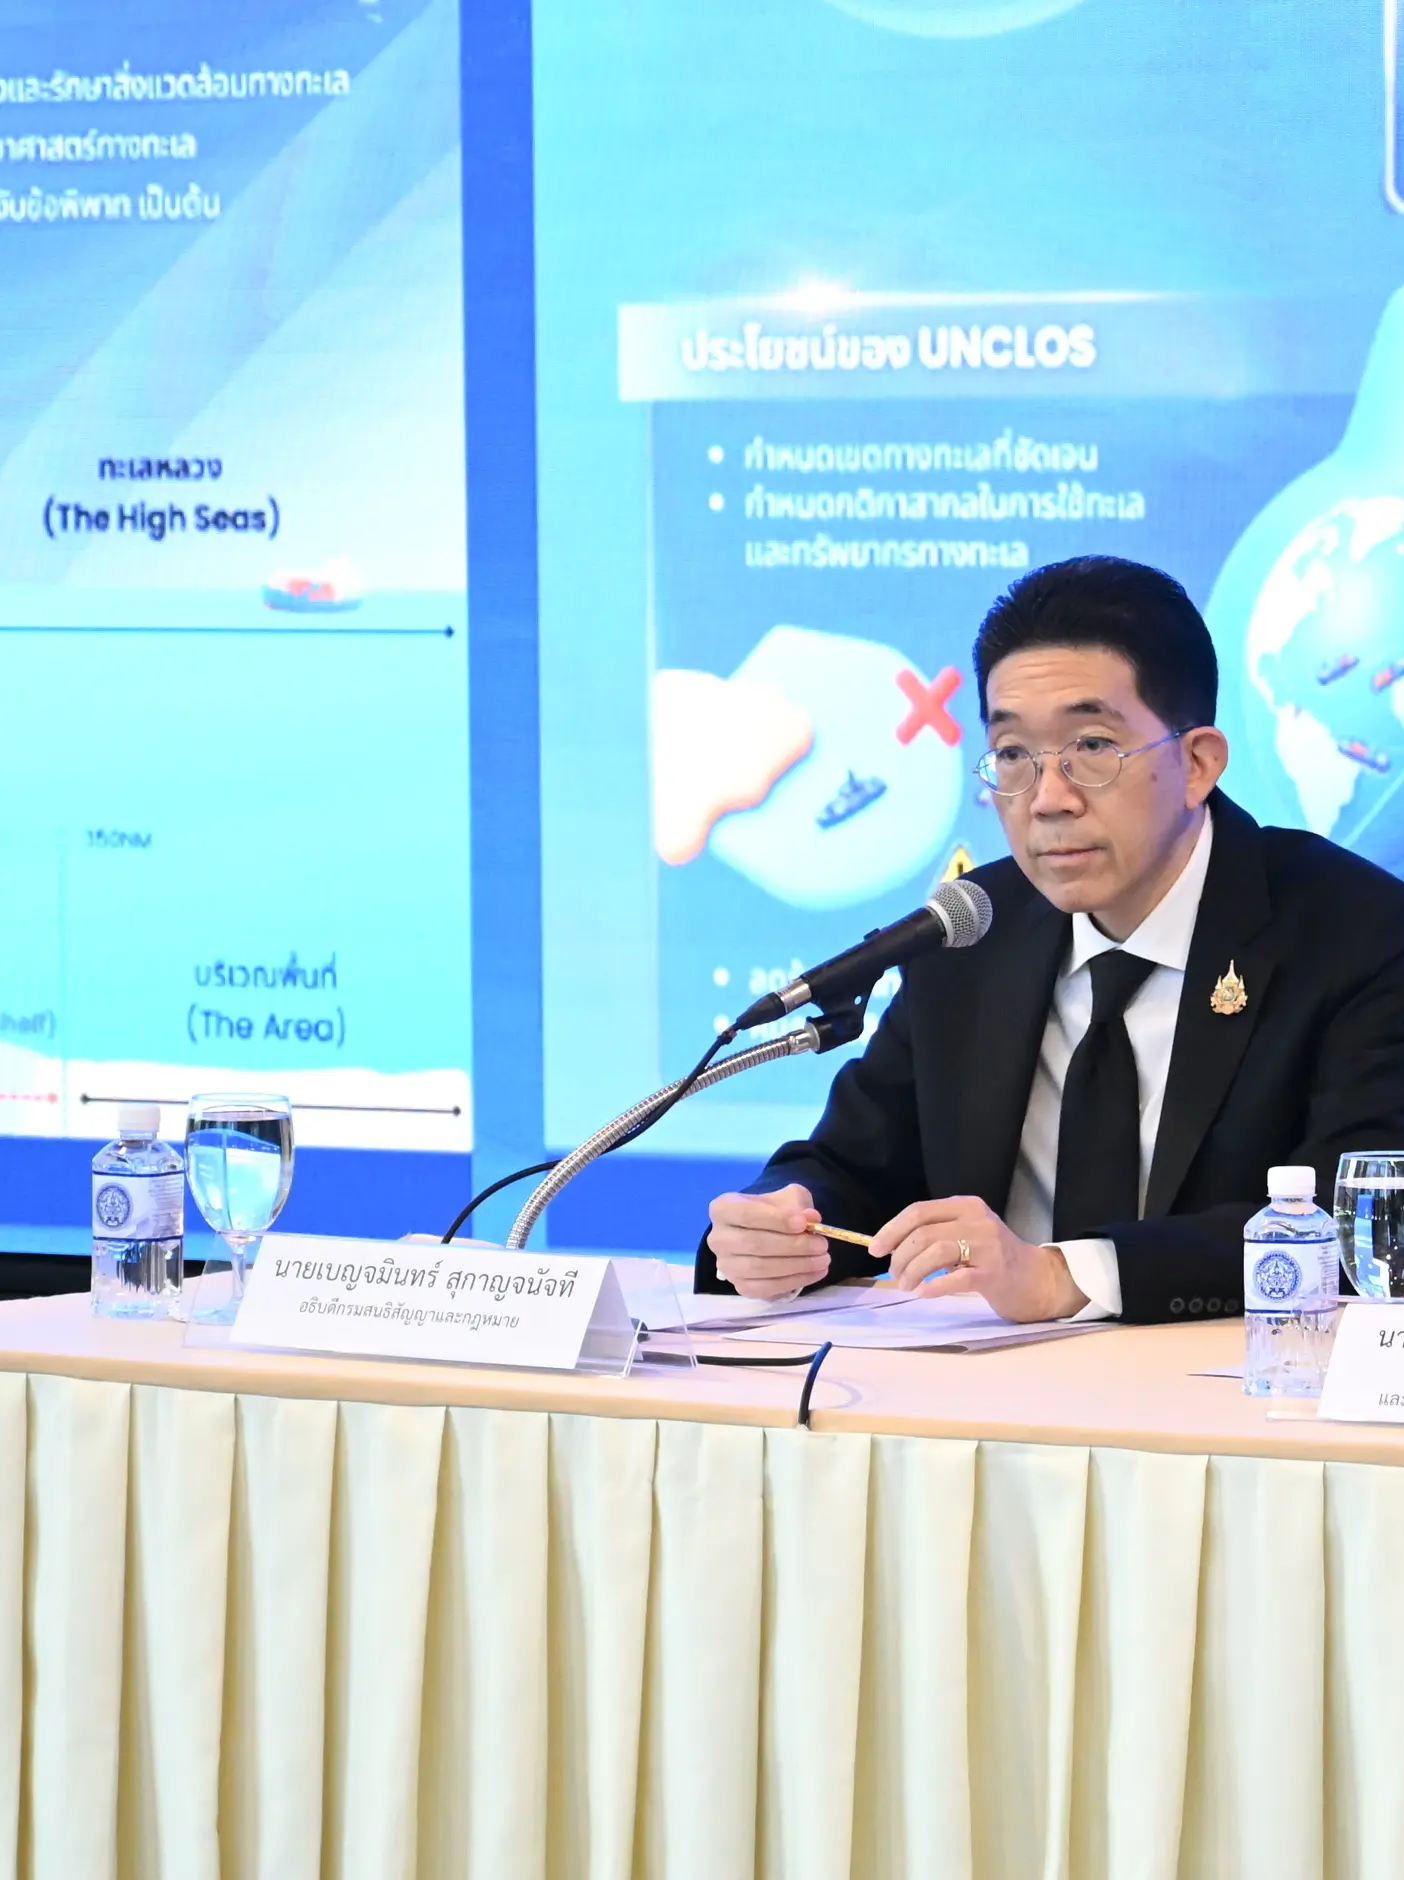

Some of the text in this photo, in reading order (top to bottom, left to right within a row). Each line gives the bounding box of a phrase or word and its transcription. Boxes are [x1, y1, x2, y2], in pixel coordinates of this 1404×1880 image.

[138, 182, 221, 220] เป็นต้น
[681, 320, 1096, 371] ประโยชน์ของ UNCLOS
[43, 495, 280, 542] (The High Seas)
[186, 1003, 346, 1048] (The Area)
[275, 1257, 443, 1291] นายเบญจมินทร์
[299, 1296, 520, 1331] อธิบดีกรมสนธิสัญญาและกฎหมาย
